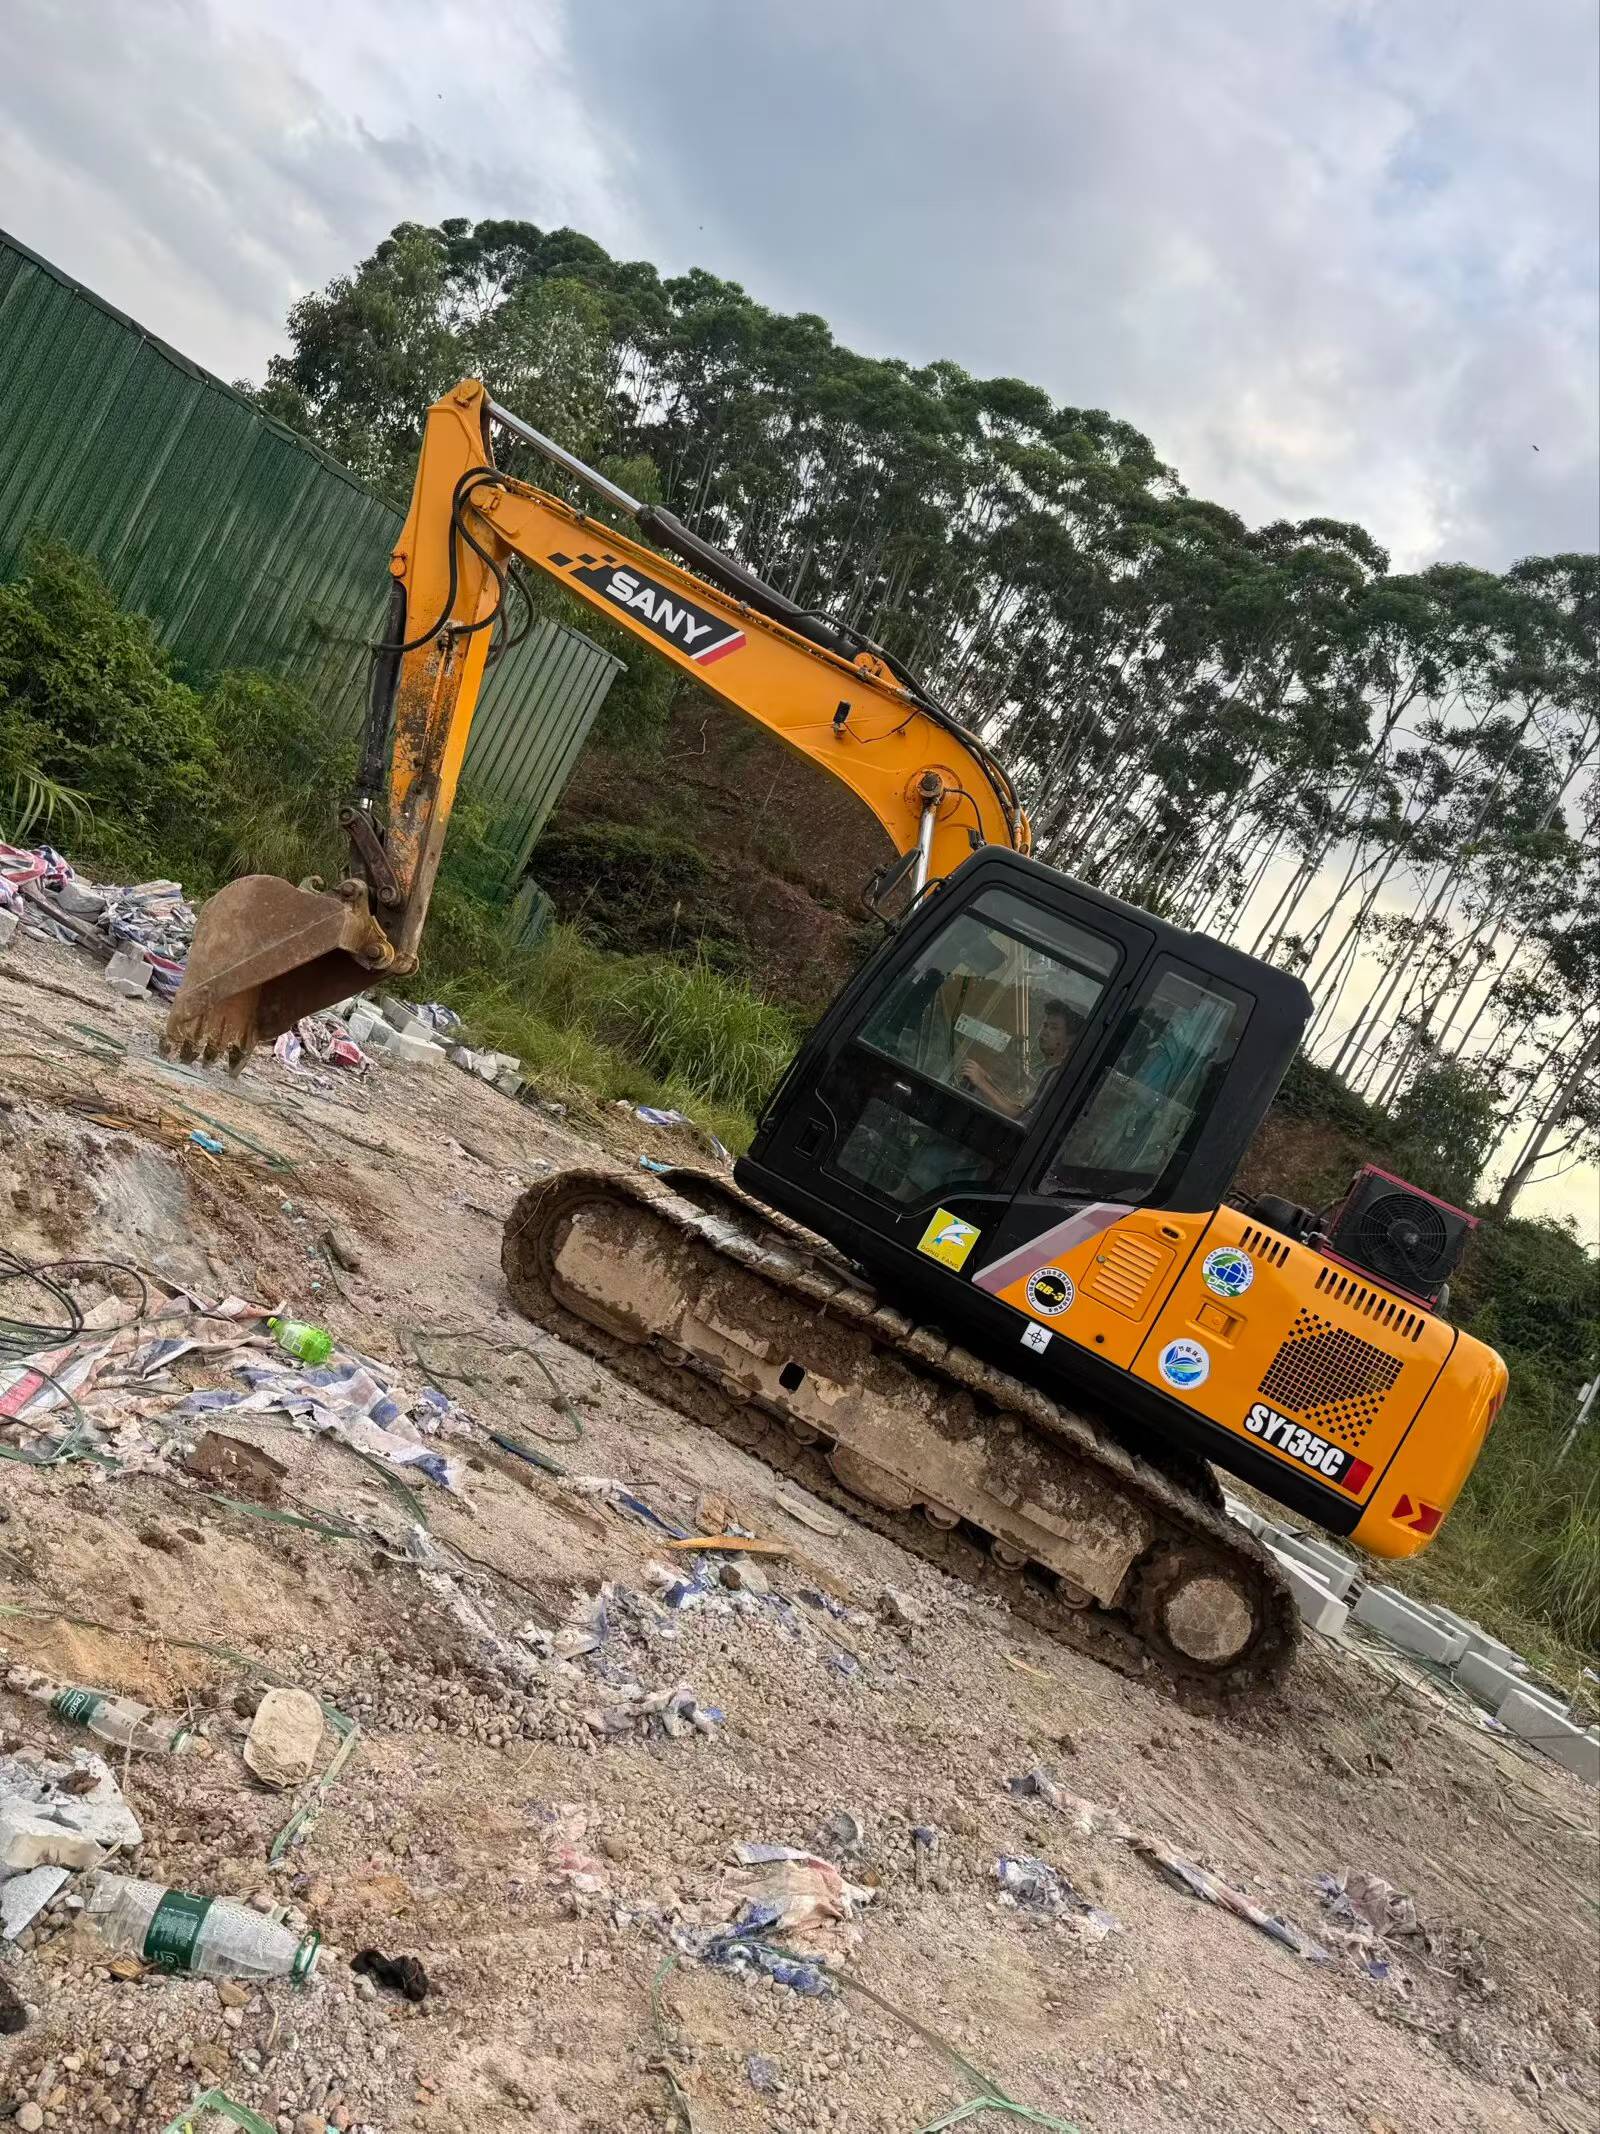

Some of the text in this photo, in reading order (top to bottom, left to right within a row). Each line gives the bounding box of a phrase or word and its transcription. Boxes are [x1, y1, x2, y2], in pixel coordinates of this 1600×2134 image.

[605, 571, 713, 645] SANY
[1035, 1281, 1065, 1302] GB-3
[1207, 1275, 1237, 1294] DPC
[1245, 1403, 1345, 1476] SY135C
